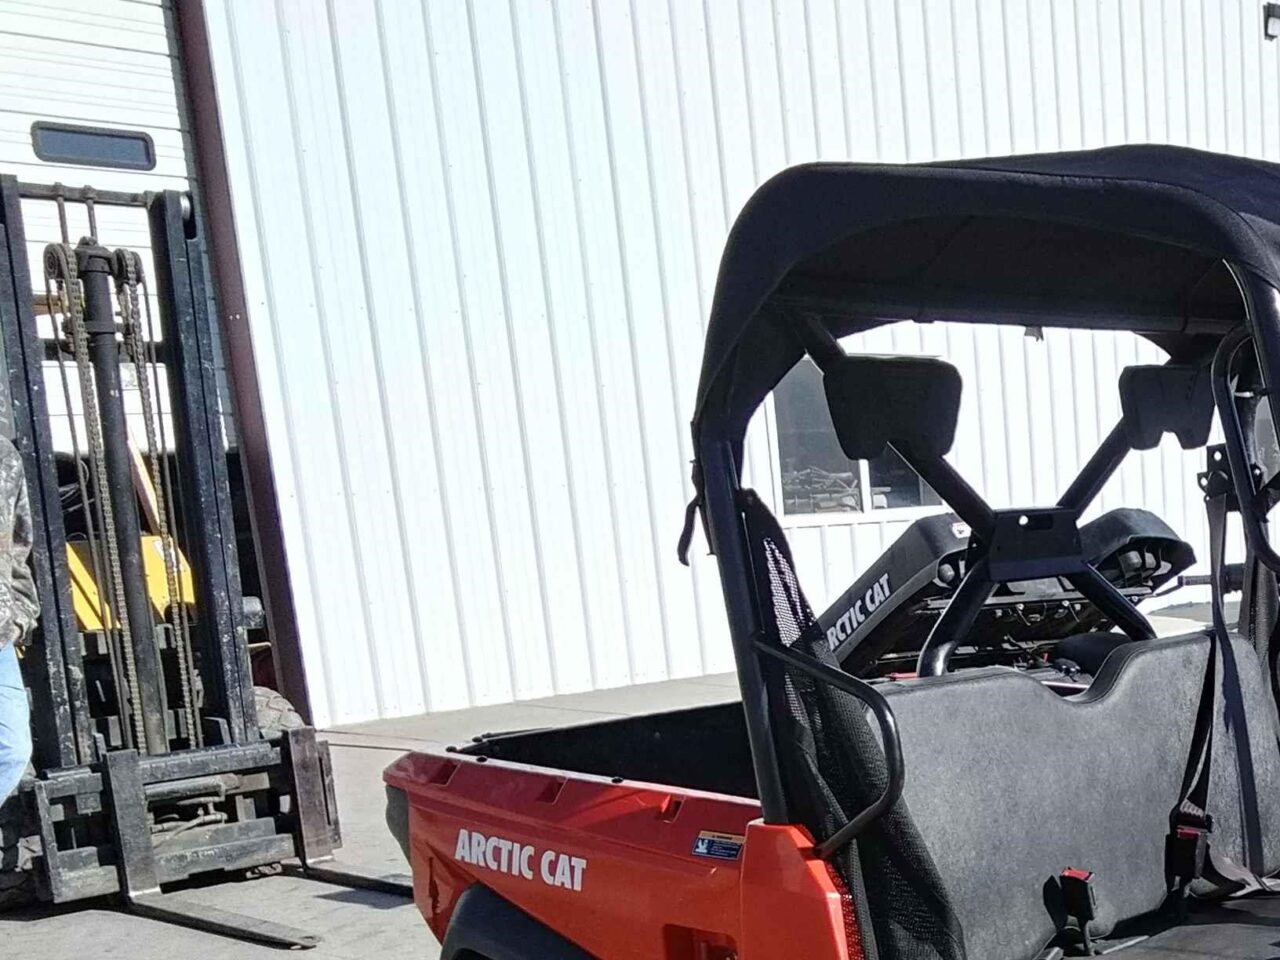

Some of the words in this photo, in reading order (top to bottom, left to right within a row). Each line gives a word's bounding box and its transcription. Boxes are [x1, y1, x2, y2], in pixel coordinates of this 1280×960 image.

[826, 599, 866, 652] RCTIC
[865, 573, 891, 613] CAT
[454, 829, 534, 880] ARCTIC
[540, 851, 587, 892] CAT
